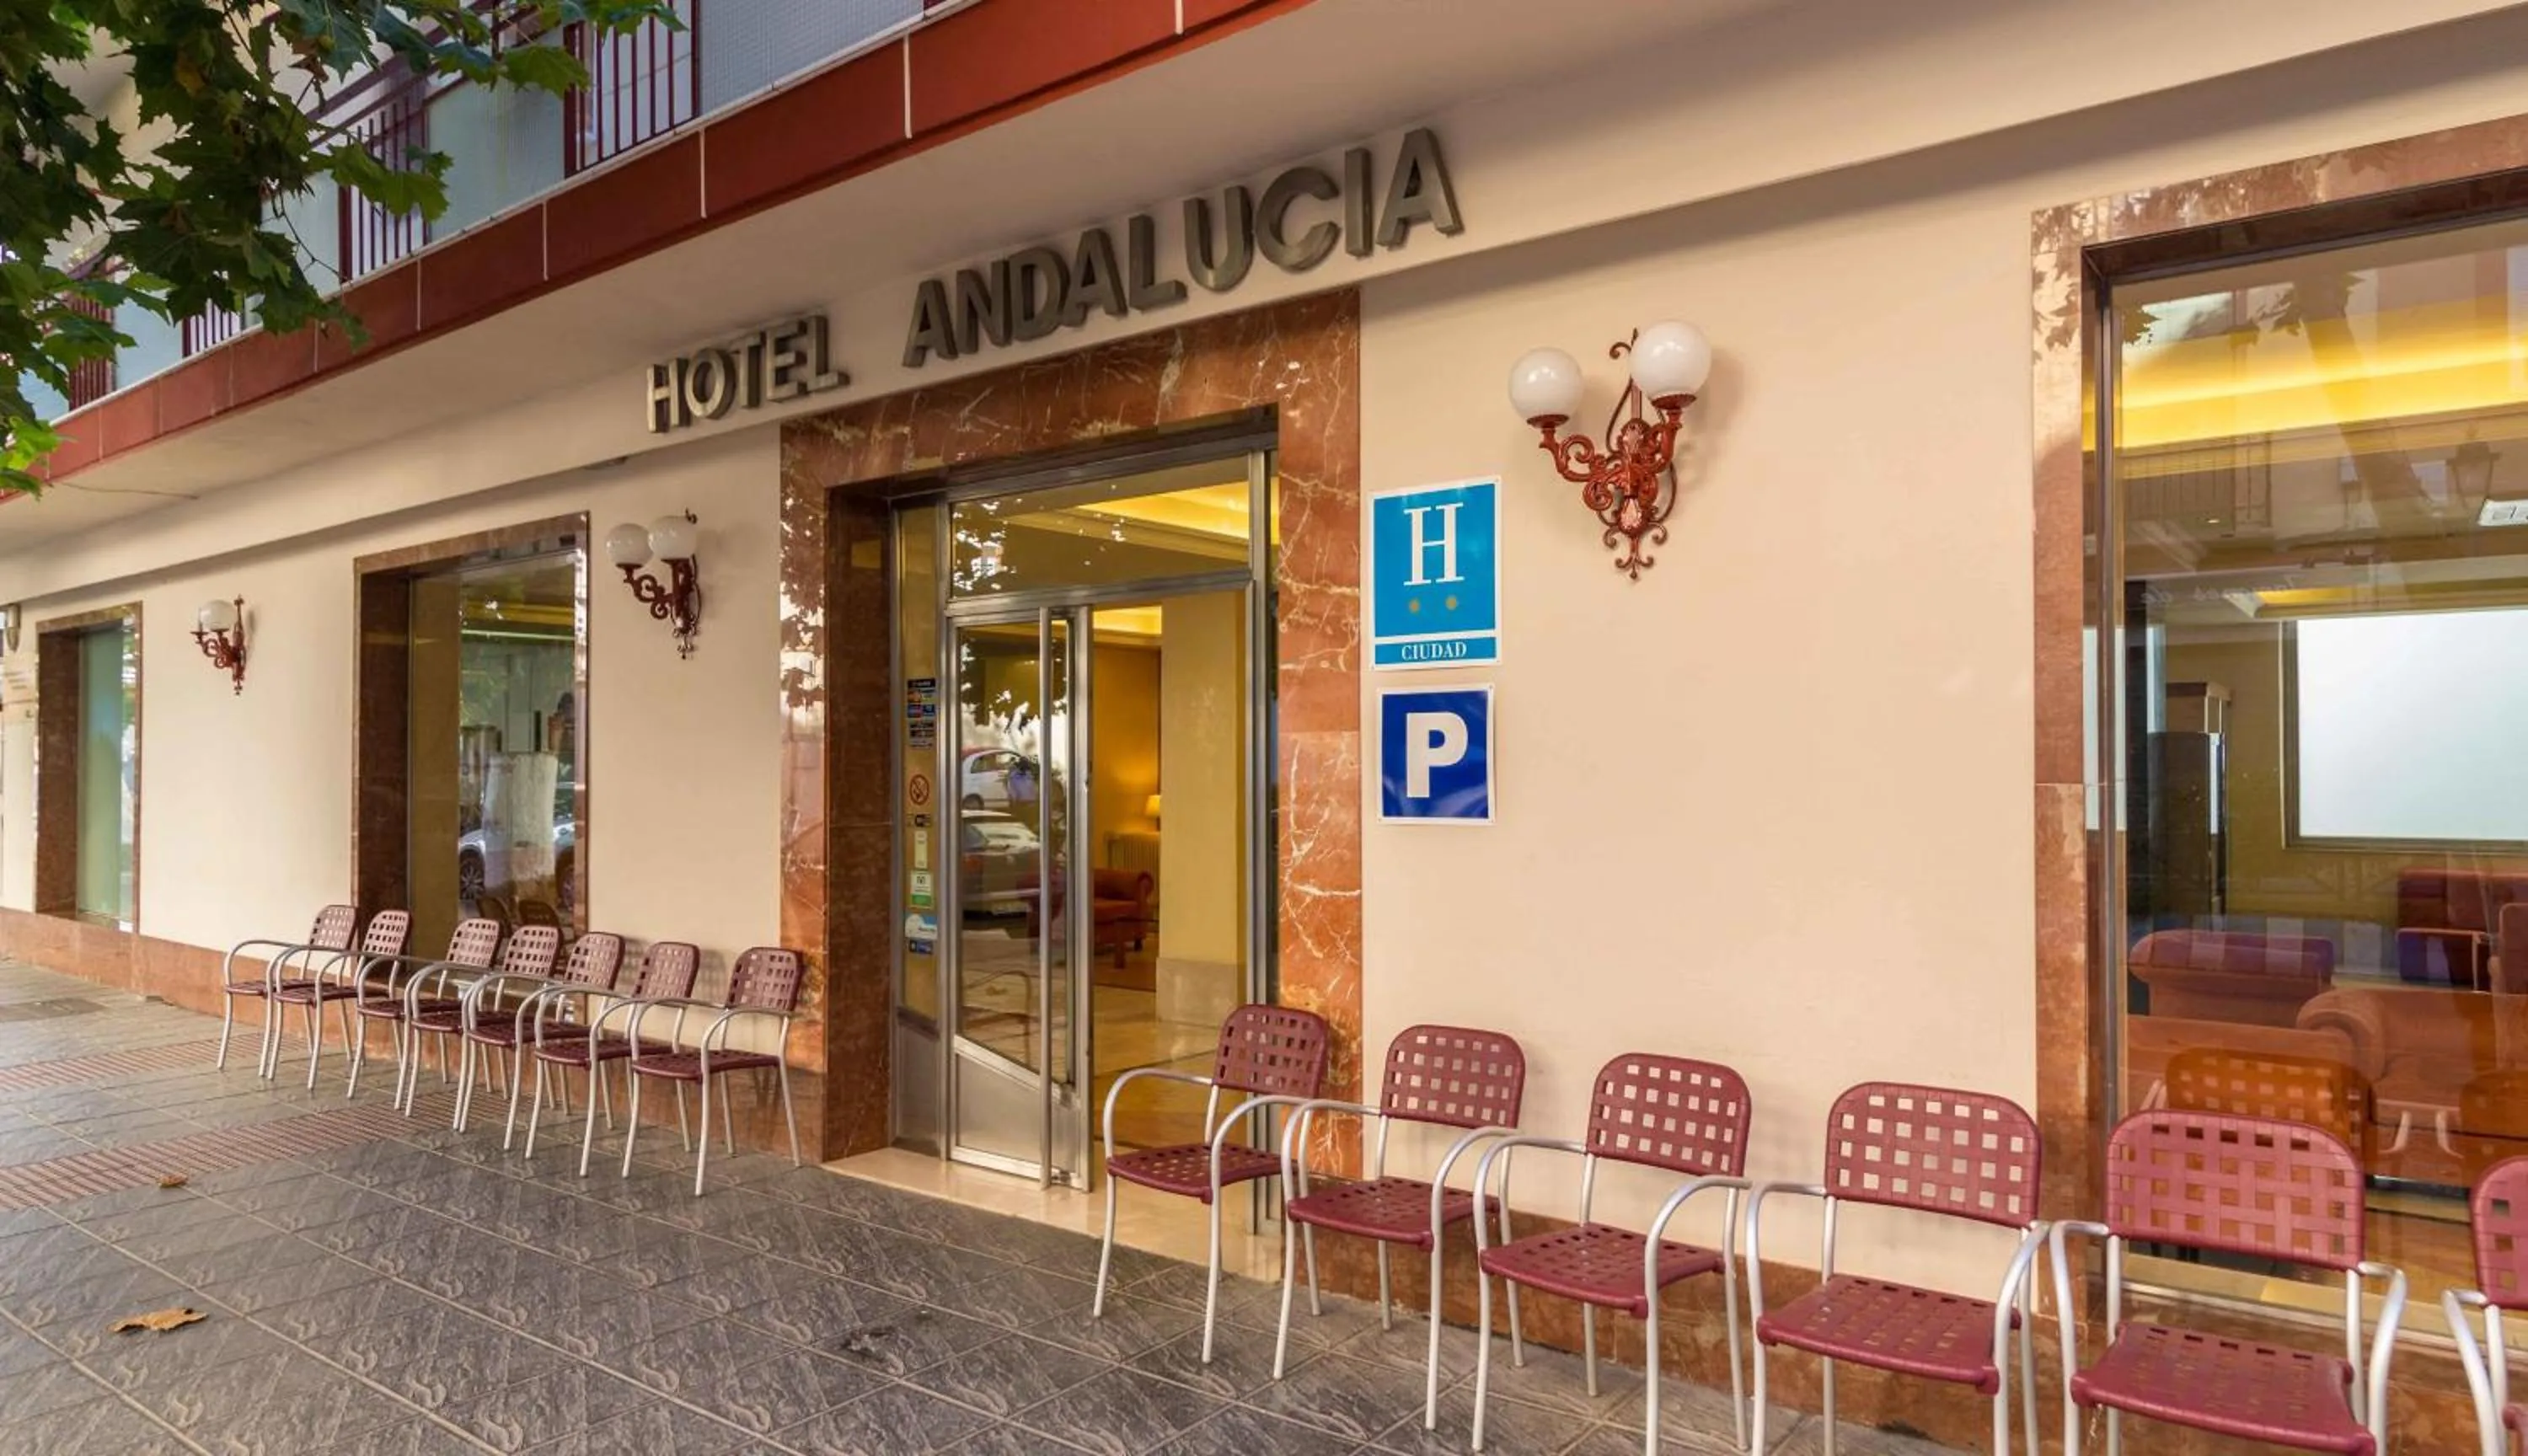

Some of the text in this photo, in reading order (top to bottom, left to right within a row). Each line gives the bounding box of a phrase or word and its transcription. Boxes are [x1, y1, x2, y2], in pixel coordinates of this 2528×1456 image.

[646, 126, 1465, 433] HOTEL ANDALUCIA
[1403, 502, 1465, 586] H
[1401, 641, 1467, 661] CIUDAD
[1406, 712, 1468, 798] P
